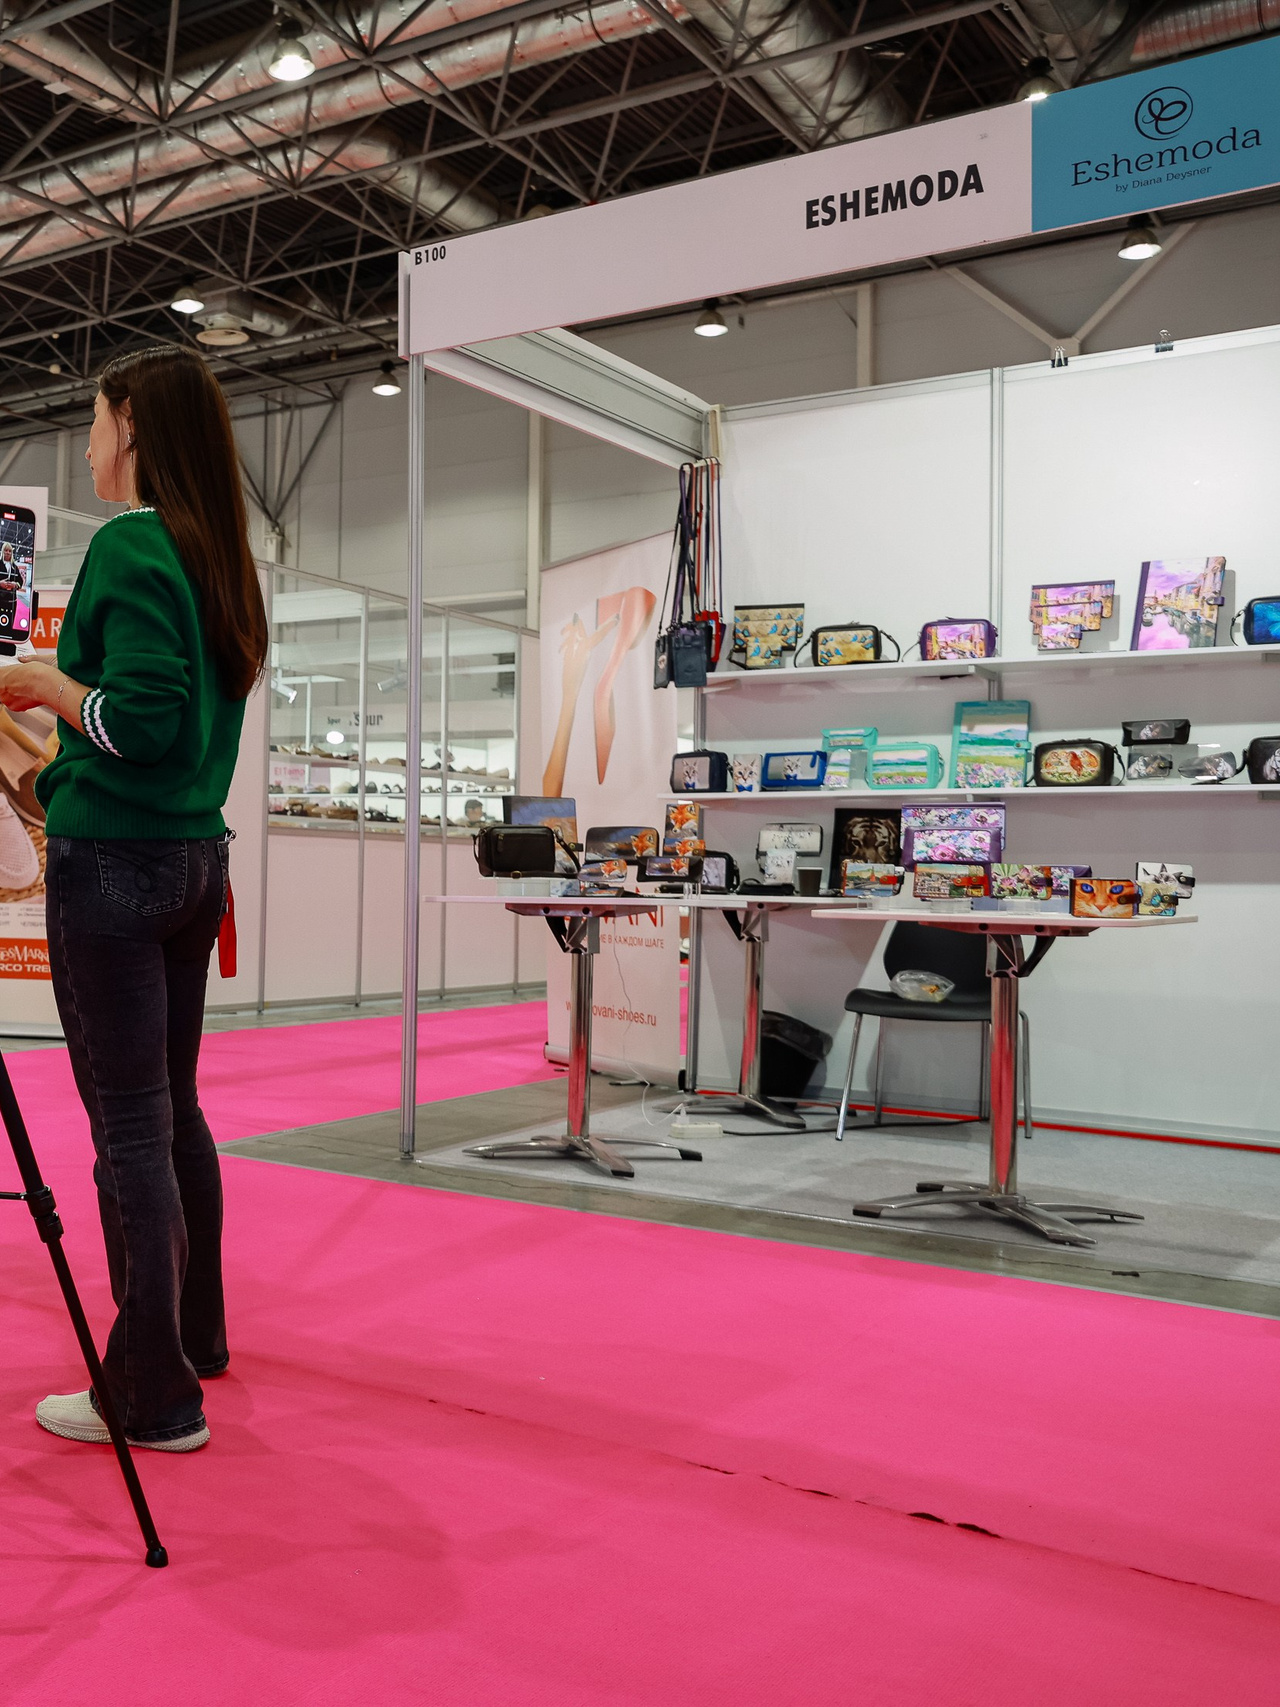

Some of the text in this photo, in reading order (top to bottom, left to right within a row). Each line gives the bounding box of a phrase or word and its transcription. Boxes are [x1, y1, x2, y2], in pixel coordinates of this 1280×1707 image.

[1071, 126, 1262, 187] Eshemoda
[805, 163, 985, 230] ESHEMODA
[1115, 166, 1213, 193] by Diana Deysner
[414, 245, 447, 266] B100
